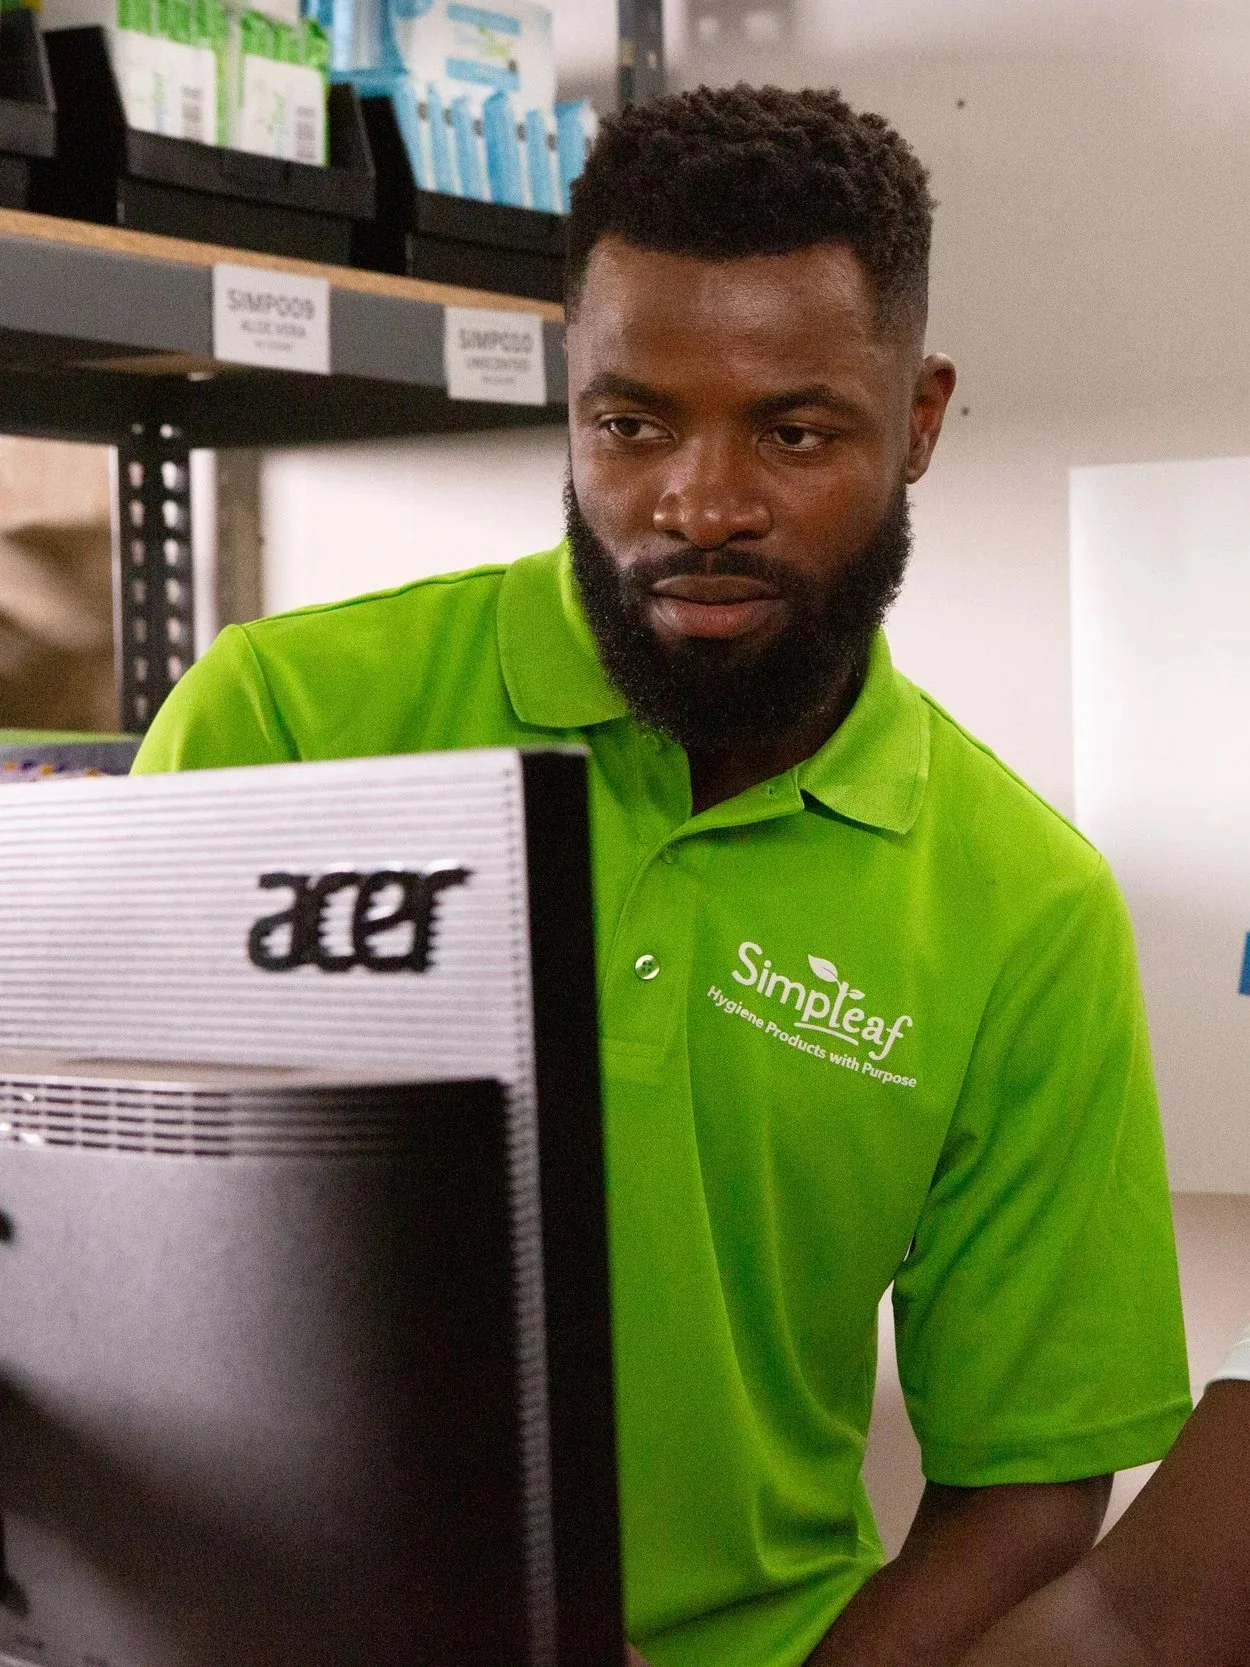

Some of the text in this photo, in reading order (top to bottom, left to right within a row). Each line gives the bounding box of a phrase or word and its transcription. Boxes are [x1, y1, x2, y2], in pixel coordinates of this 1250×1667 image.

[248, 864, 476, 974] acer
[707, 985, 917, 1088] Hygiene Products with Purpose
[732, 941, 913, 1061] Simpleaf
